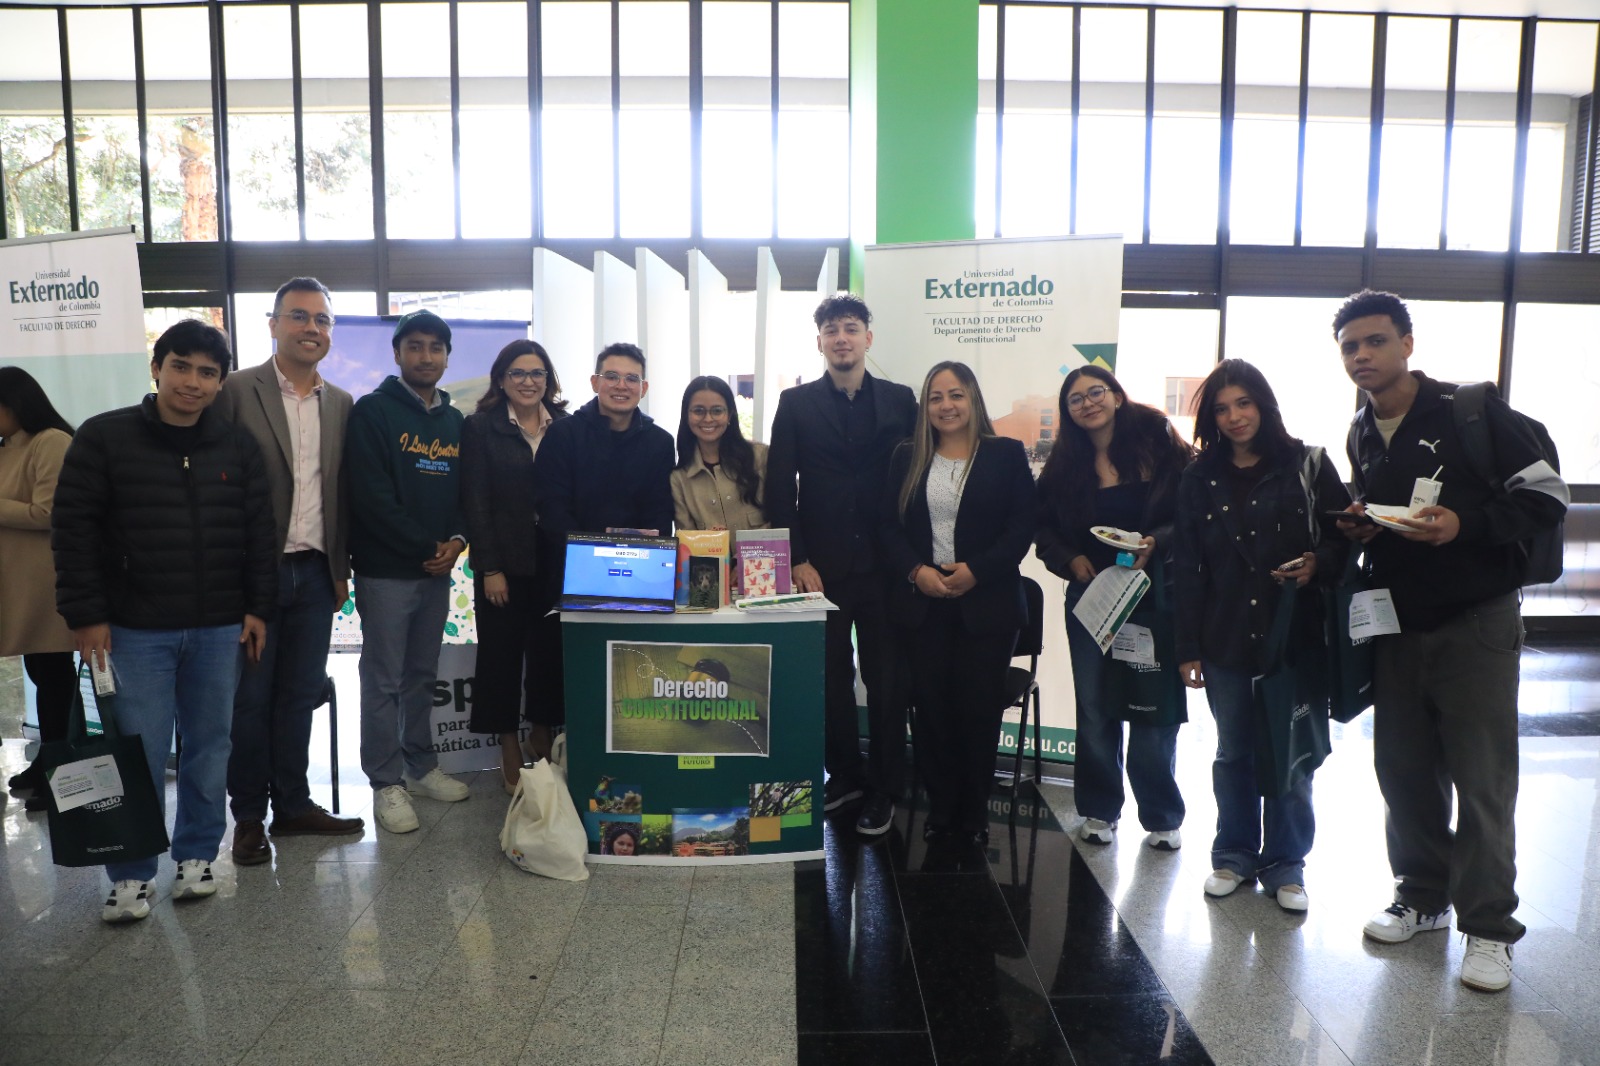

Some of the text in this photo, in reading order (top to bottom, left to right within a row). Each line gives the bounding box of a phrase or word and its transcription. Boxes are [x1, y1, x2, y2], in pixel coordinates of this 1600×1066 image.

[35, 268, 71, 280] Universidad
[963, 268, 1014, 278] Universidad
[9, 275, 99, 304] Externado
[925, 274, 1054, 299] Externado
[59, 300, 101, 312] de Colombia
[992, 298, 1054, 307] de Colombia
[20, 319, 97, 332] FACULTAD DE DERECHO
[932, 315, 1043, 326] FACULTAD DE DERECHO
[934, 325, 1041, 336] Departamento de Derecho
[957, 334, 1016, 344] Constitucional
[400, 432, 460, 460] I Lose Control
[653, 677, 728, 698] Derecho
[621, 698, 759, 721] CONSTITUCIONAL
